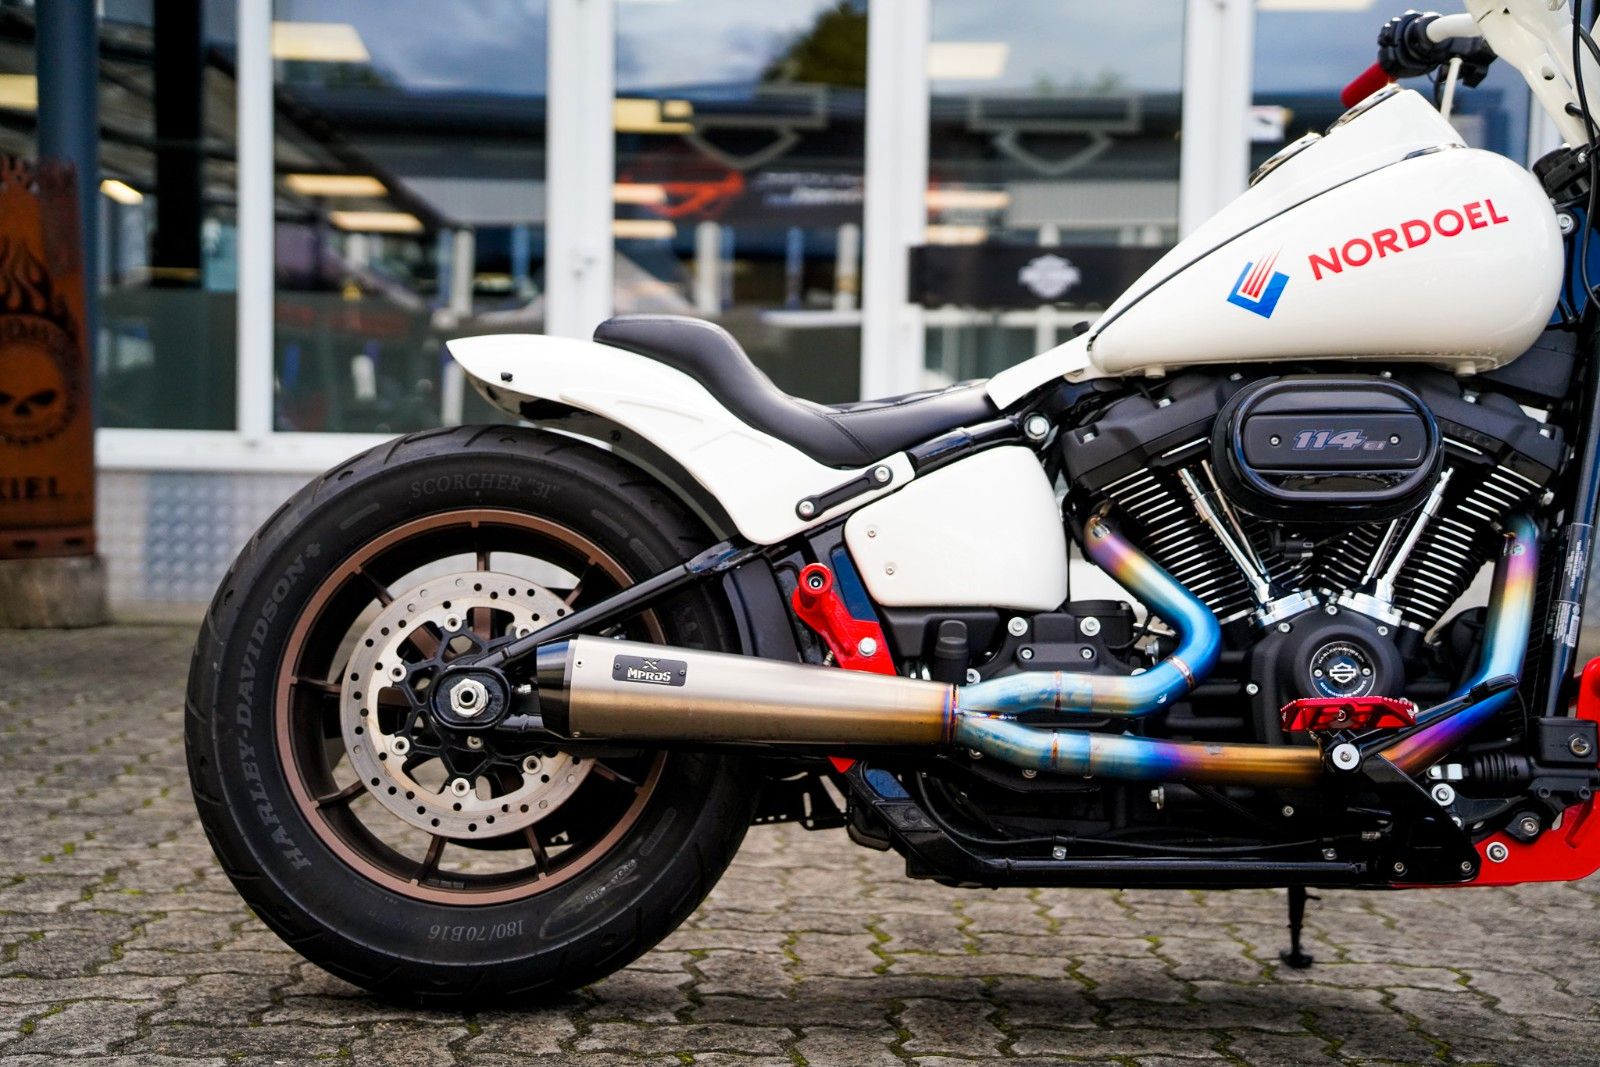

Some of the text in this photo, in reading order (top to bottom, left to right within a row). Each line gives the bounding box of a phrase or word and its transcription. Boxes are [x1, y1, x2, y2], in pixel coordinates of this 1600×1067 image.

[1308, 198, 1509, 281] NORDOEL
[1292, 428, 1367, 450] 114
[410, 472, 522, 498] SCORCHER
[236, 554, 312, 871] HARLEY-DAVIDSON
